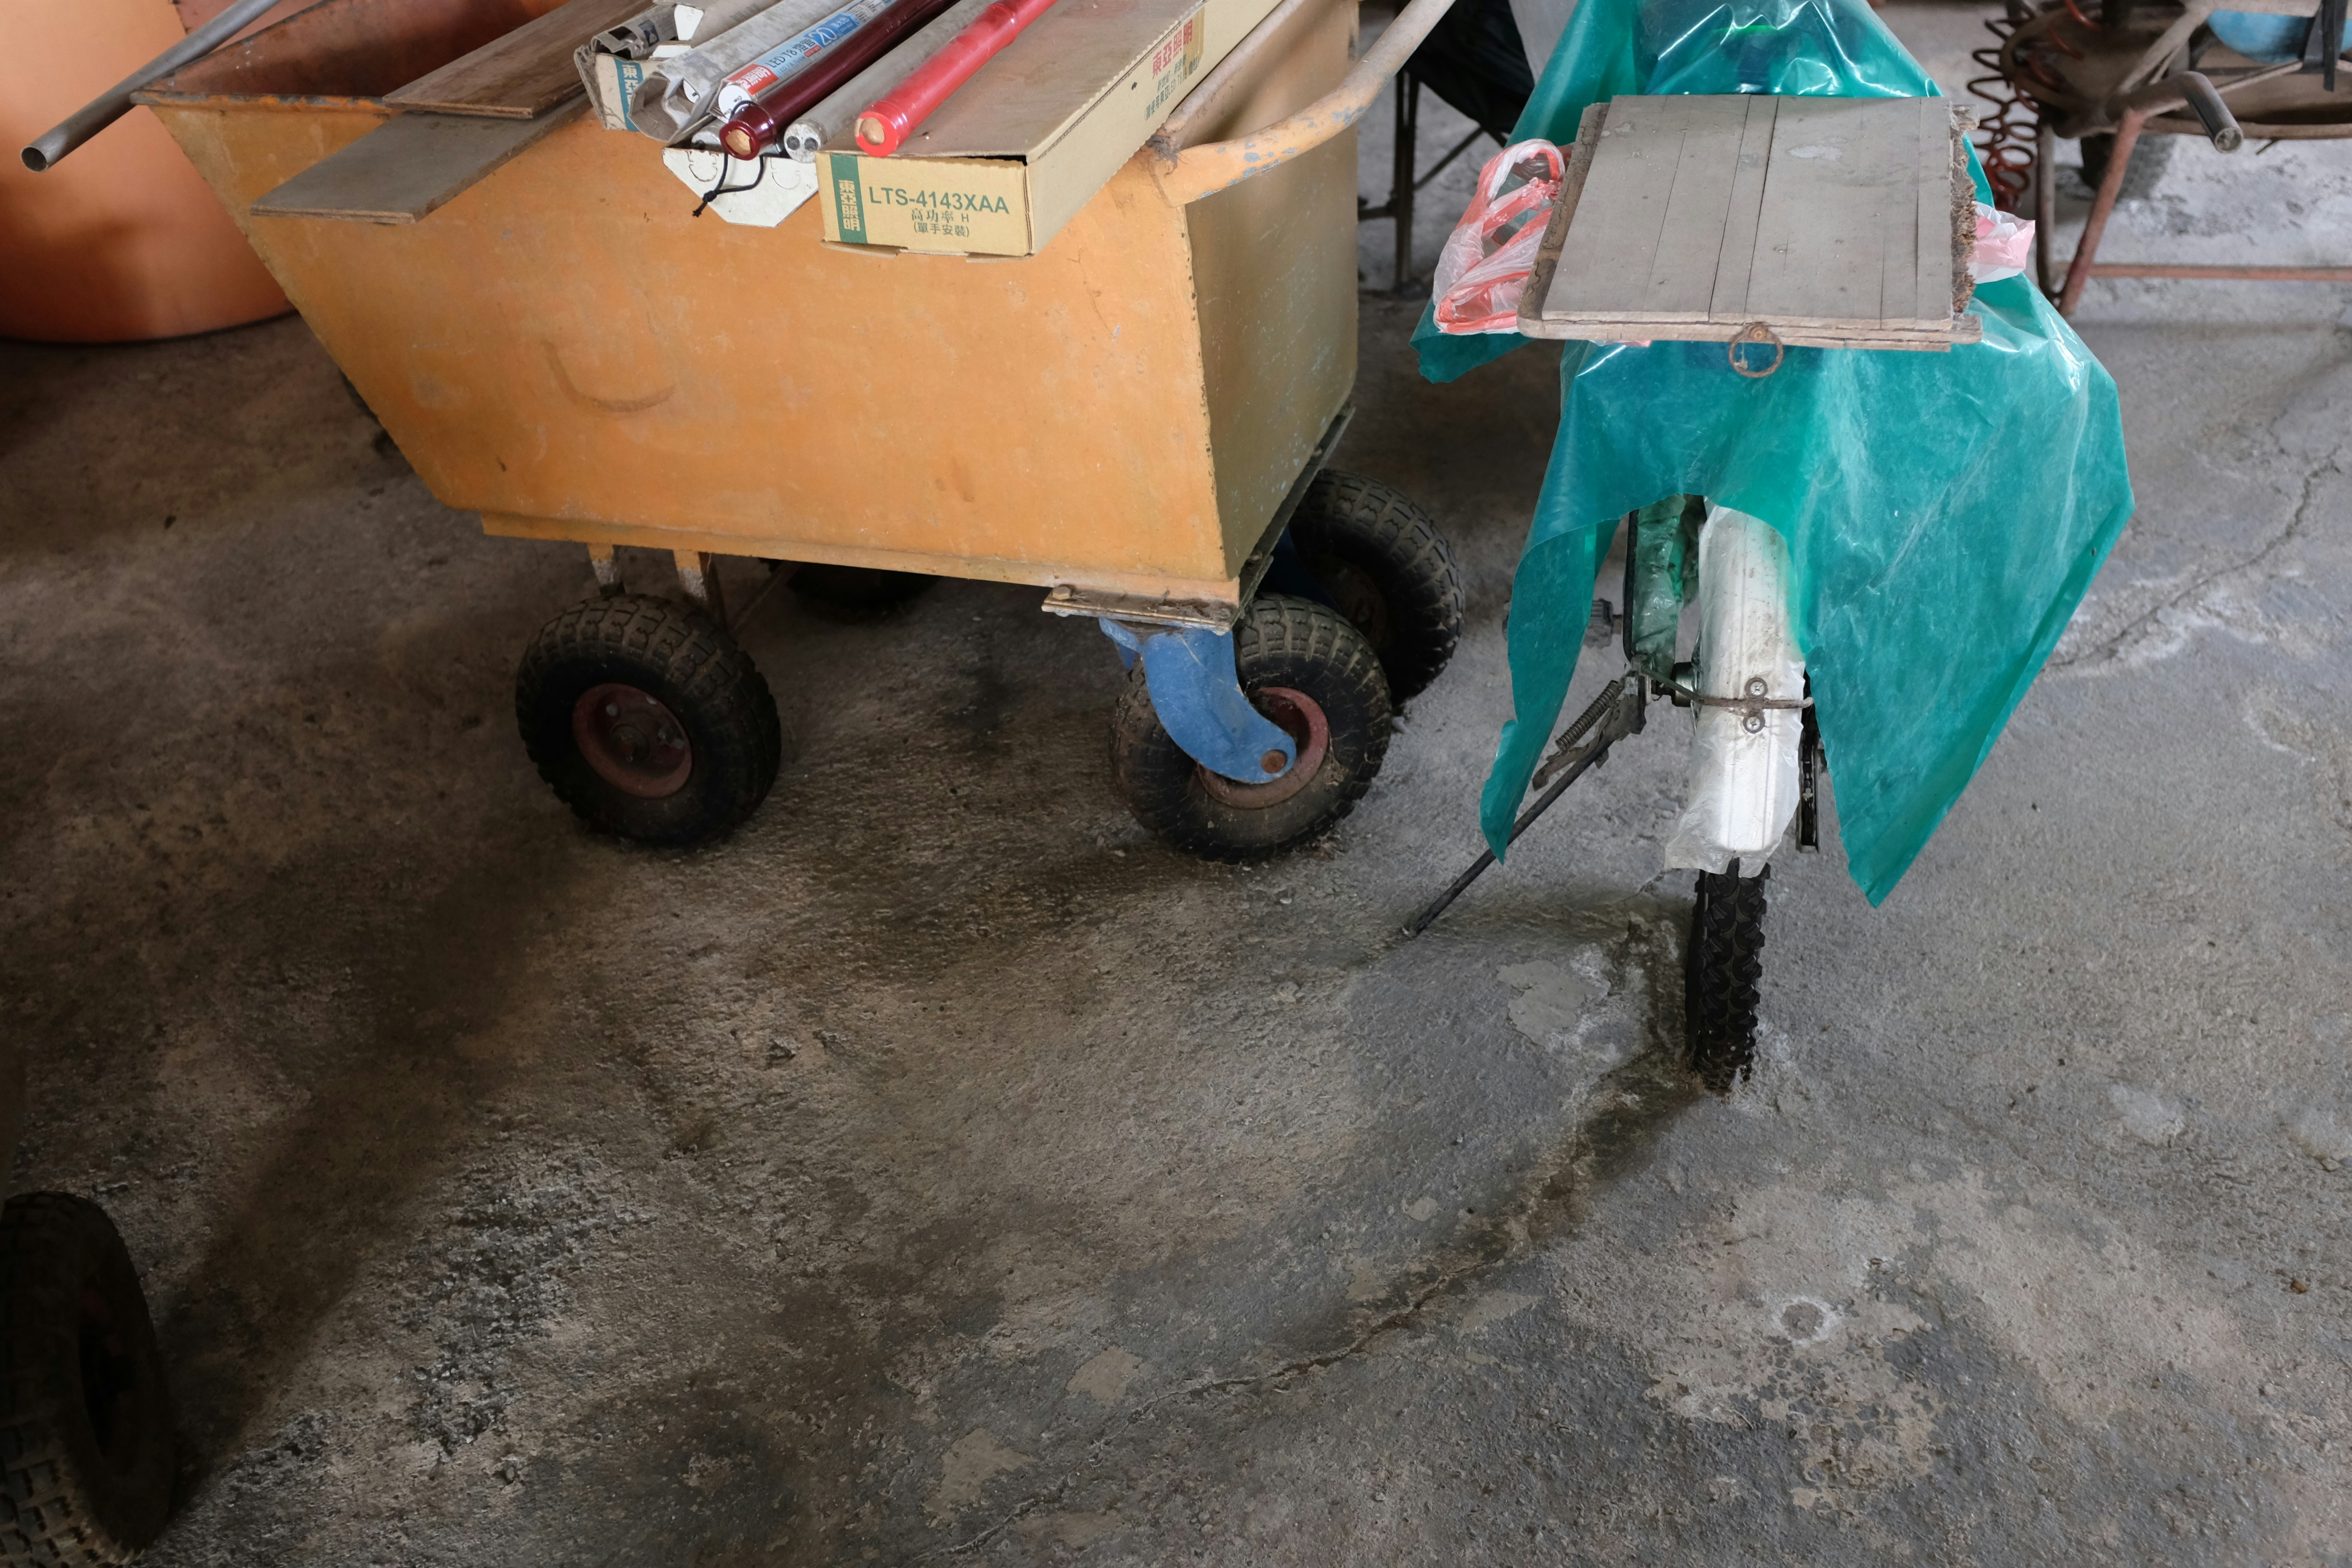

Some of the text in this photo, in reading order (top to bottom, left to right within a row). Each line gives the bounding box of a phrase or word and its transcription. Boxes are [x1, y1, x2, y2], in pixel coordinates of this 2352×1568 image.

[808, 27, 838, 46] 20
[1152, 19, 1193, 80] 東亞照明
[765, 56, 786, 68] LED
[781, 49, 797, 58] T8
[792, 38, 816, 53] 燈管
[838, 180, 860, 231] 東亞照明
[869, 186, 1009, 214] LTS-4143XAA
[911, 208, 969, 223] 高功率 H
[914, 222, 969, 237] (單手安裝)
